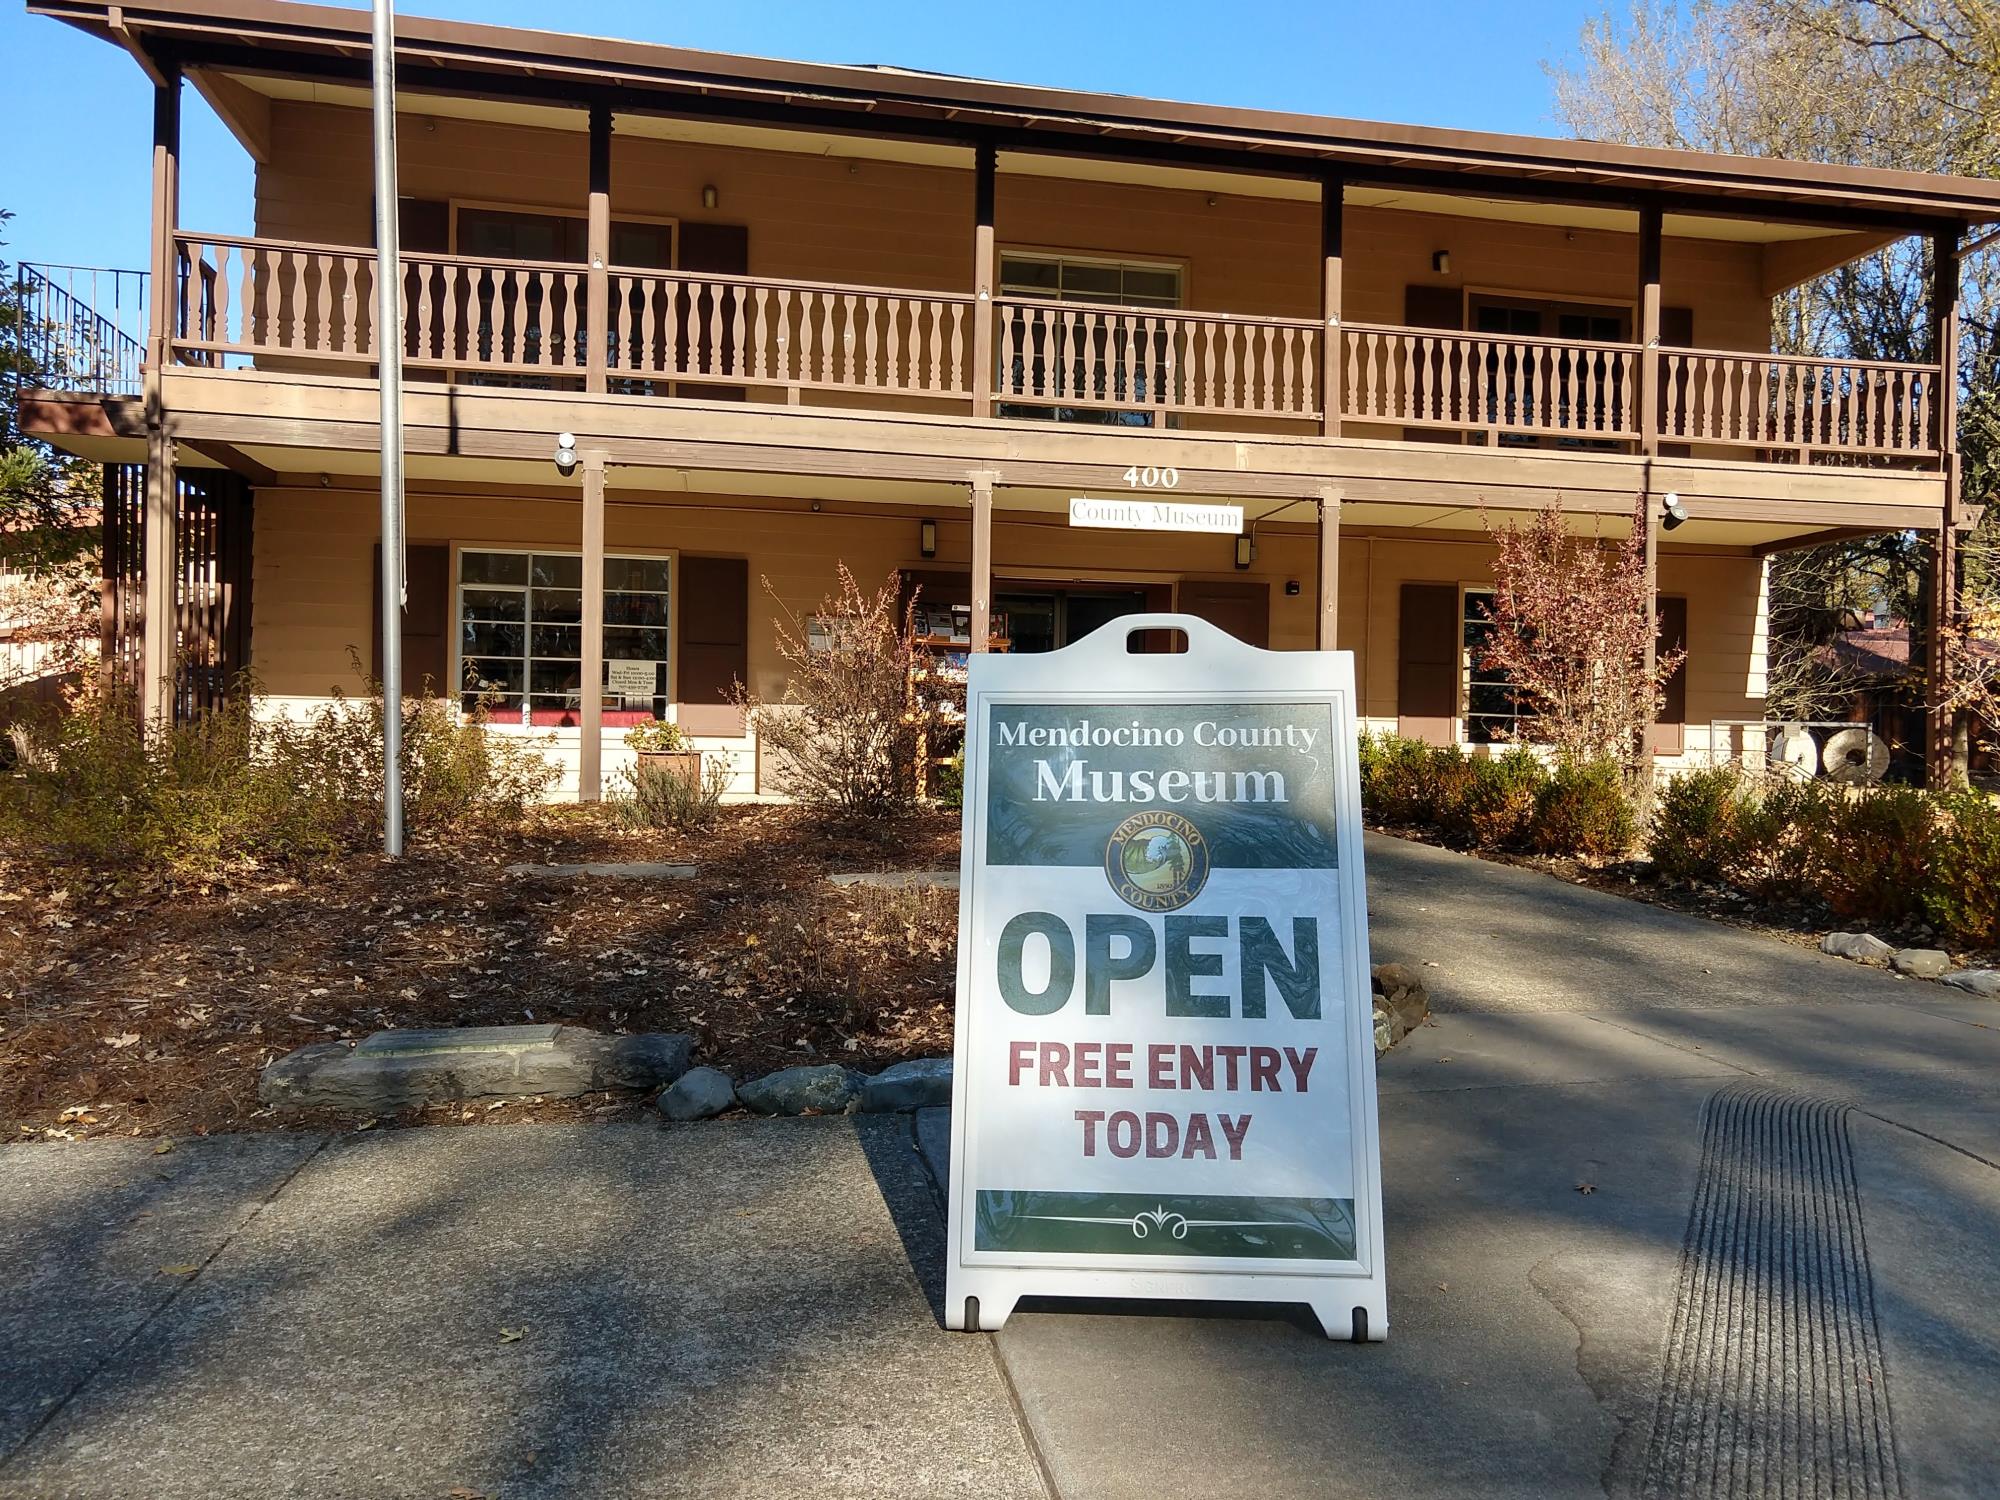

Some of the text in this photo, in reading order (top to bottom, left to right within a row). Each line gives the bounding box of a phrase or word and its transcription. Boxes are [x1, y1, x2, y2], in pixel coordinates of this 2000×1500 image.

[1122, 466, 1179, 488] 400
[1072, 501, 1239, 528] County Museum
[997, 720, 1319, 753] Mendocino County
[1032, 759, 1289, 803] Museum
[1113, 813, 1201, 845] MENDOCINO
[1121, 883, 1191, 907] COUNTY
[997, 911, 1321, 1020] OPEN
[1008, 1041, 1318, 1093] FREE ENTRY
[1074, 1110, 1252, 1161] TODAY
